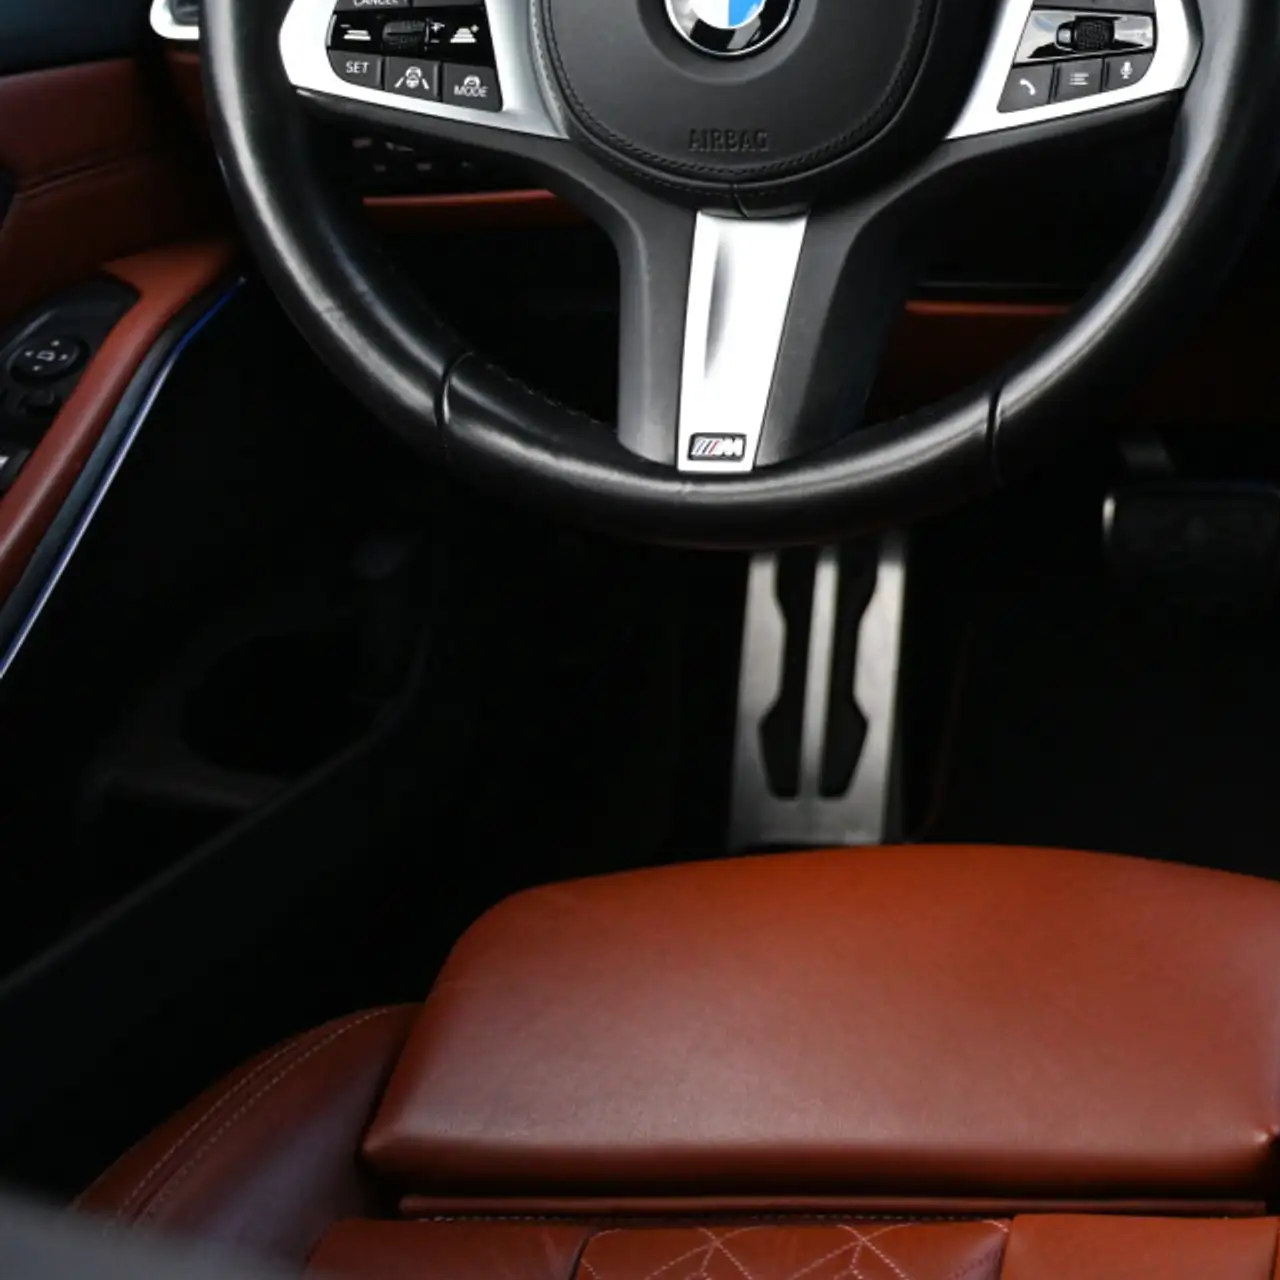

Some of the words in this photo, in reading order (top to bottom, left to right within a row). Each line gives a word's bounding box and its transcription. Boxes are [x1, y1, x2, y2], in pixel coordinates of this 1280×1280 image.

[345, 61, 370, 74] SET
[454, 84, 489, 98] MODE
[688, 128, 770, 153] AIRBAG
